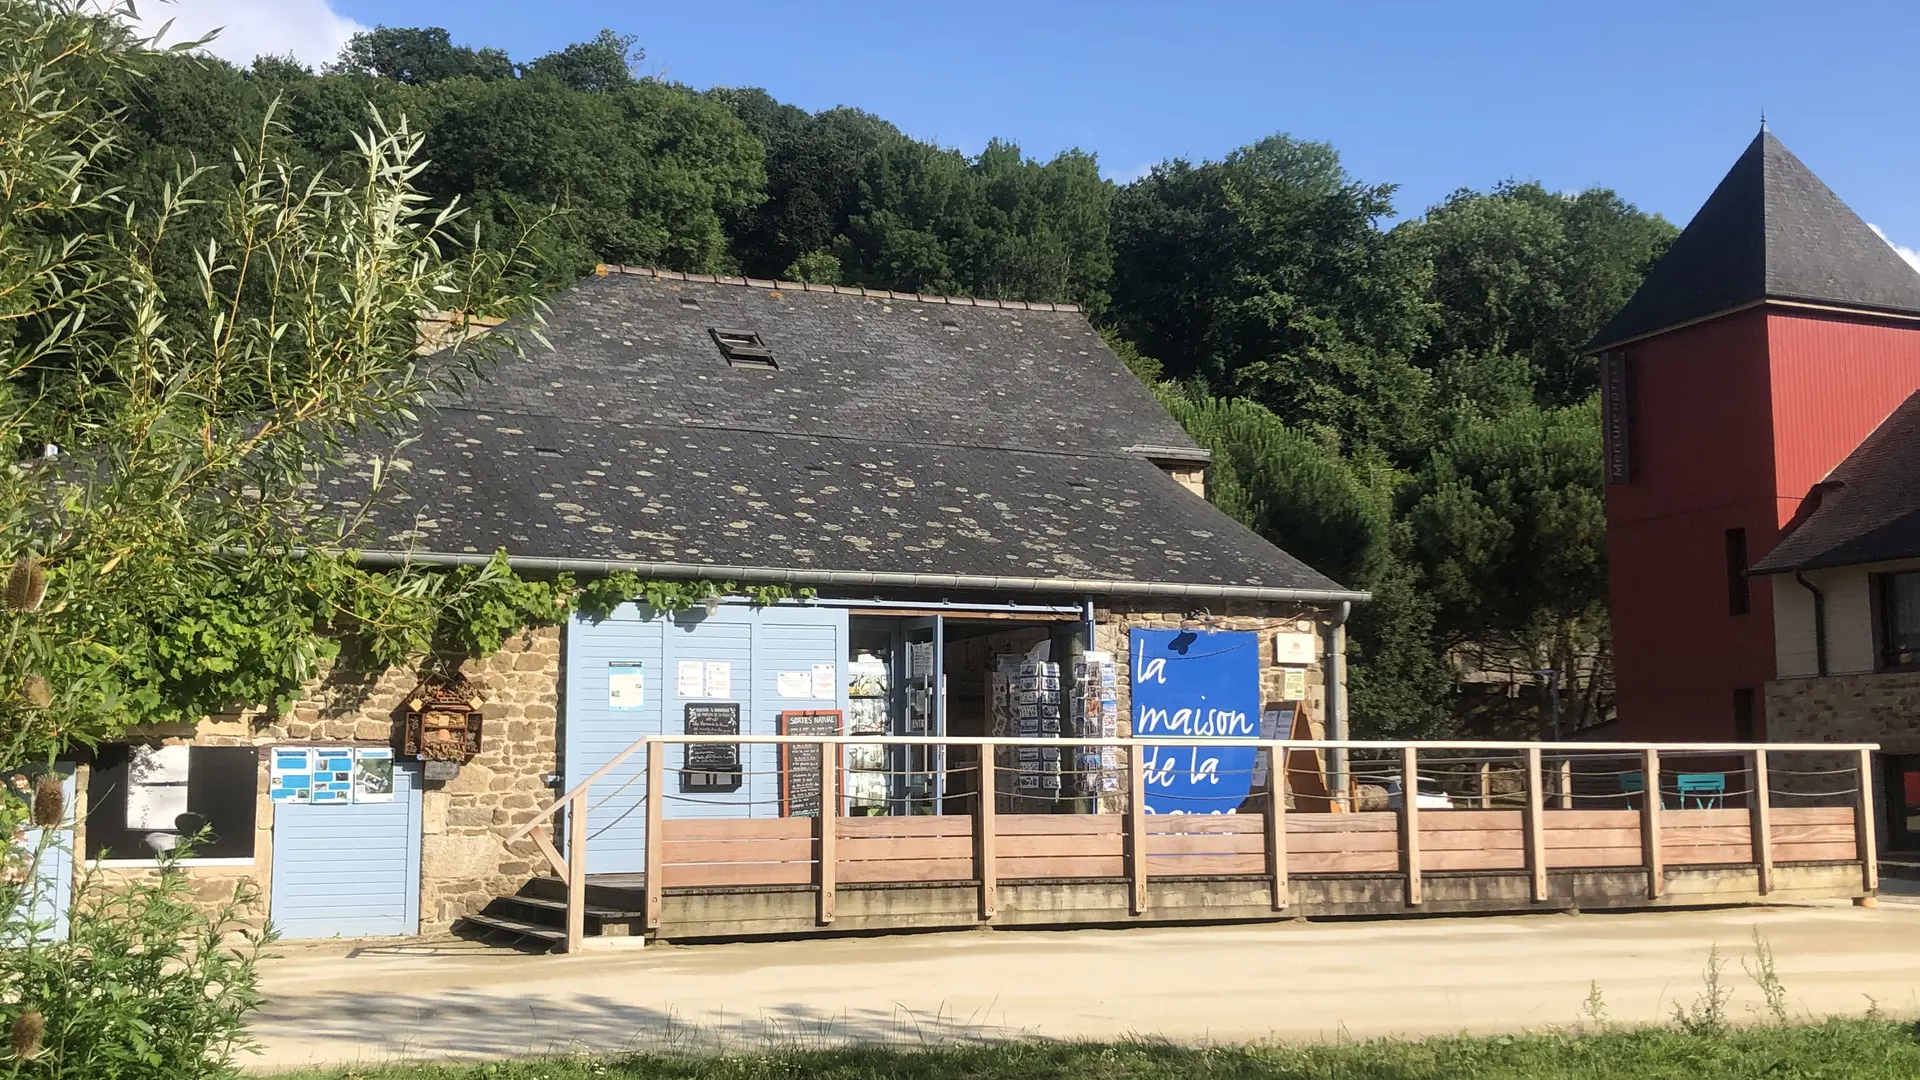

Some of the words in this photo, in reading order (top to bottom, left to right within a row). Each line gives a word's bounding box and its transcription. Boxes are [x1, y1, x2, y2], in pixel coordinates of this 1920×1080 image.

[1138, 638, 1167, 684] la
[1137, 693, 1255, 736] maison
[1143, 746, 1176, 787] de
[1190, 746, 1220, 786] la
